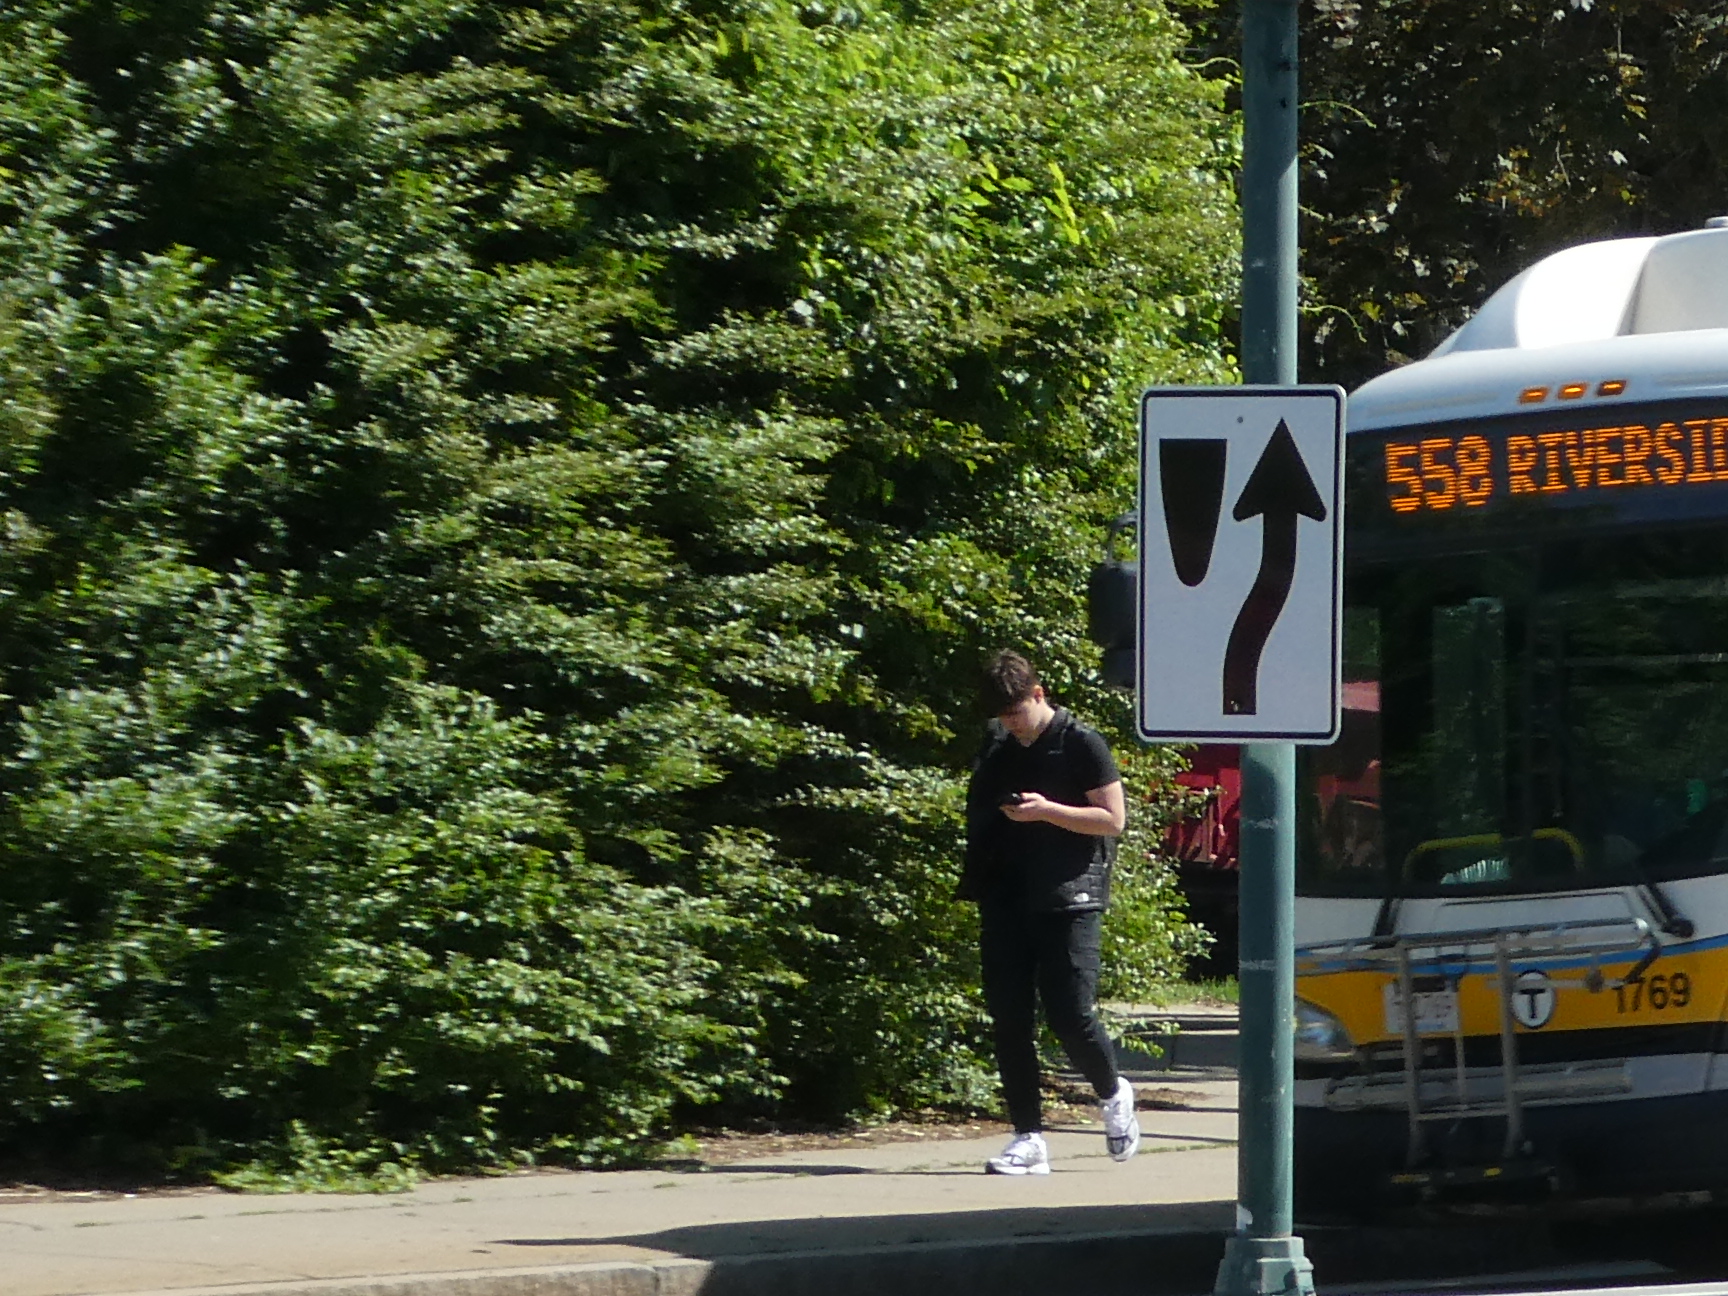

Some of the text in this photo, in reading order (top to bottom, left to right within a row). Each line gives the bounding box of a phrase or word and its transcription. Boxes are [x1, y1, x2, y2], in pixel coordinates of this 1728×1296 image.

[1385, 434, 1493, 512] 558
[1518, 988, 1547, 1020] T
[1612, 971, 1692, 1014] 1769
